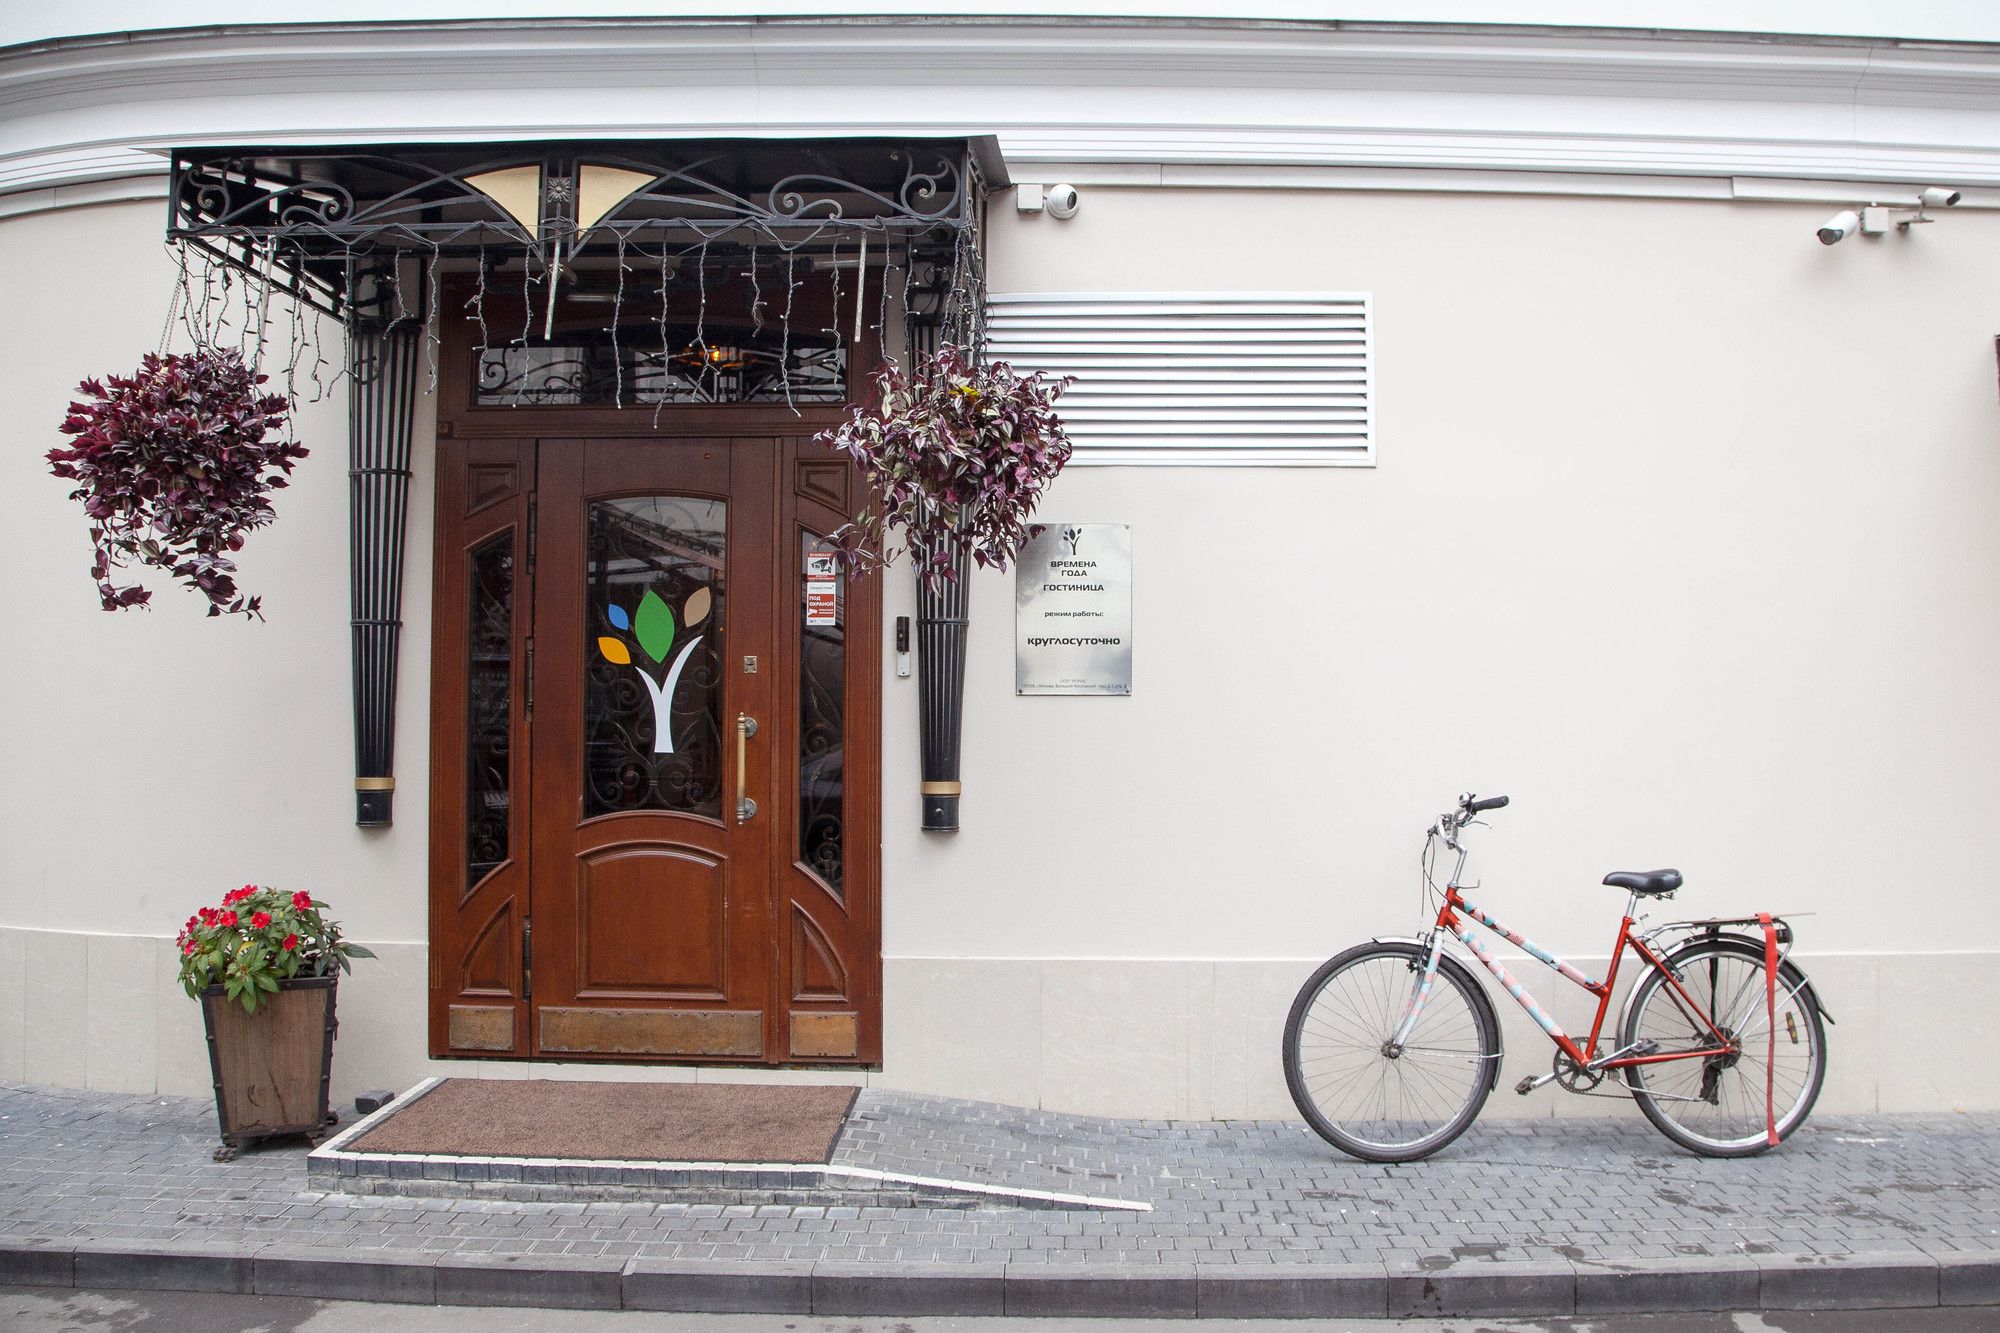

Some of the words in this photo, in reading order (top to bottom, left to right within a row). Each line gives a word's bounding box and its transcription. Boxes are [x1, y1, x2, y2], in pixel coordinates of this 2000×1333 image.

[1050, 560, 1097, 568] ВРЕМЕНА
[1043, 584, 1104, 592] ГОСТИНИЦА
[1072, 610, 1104, 618] работы:
[1027, 637, 1121, 647] круглосуточно
